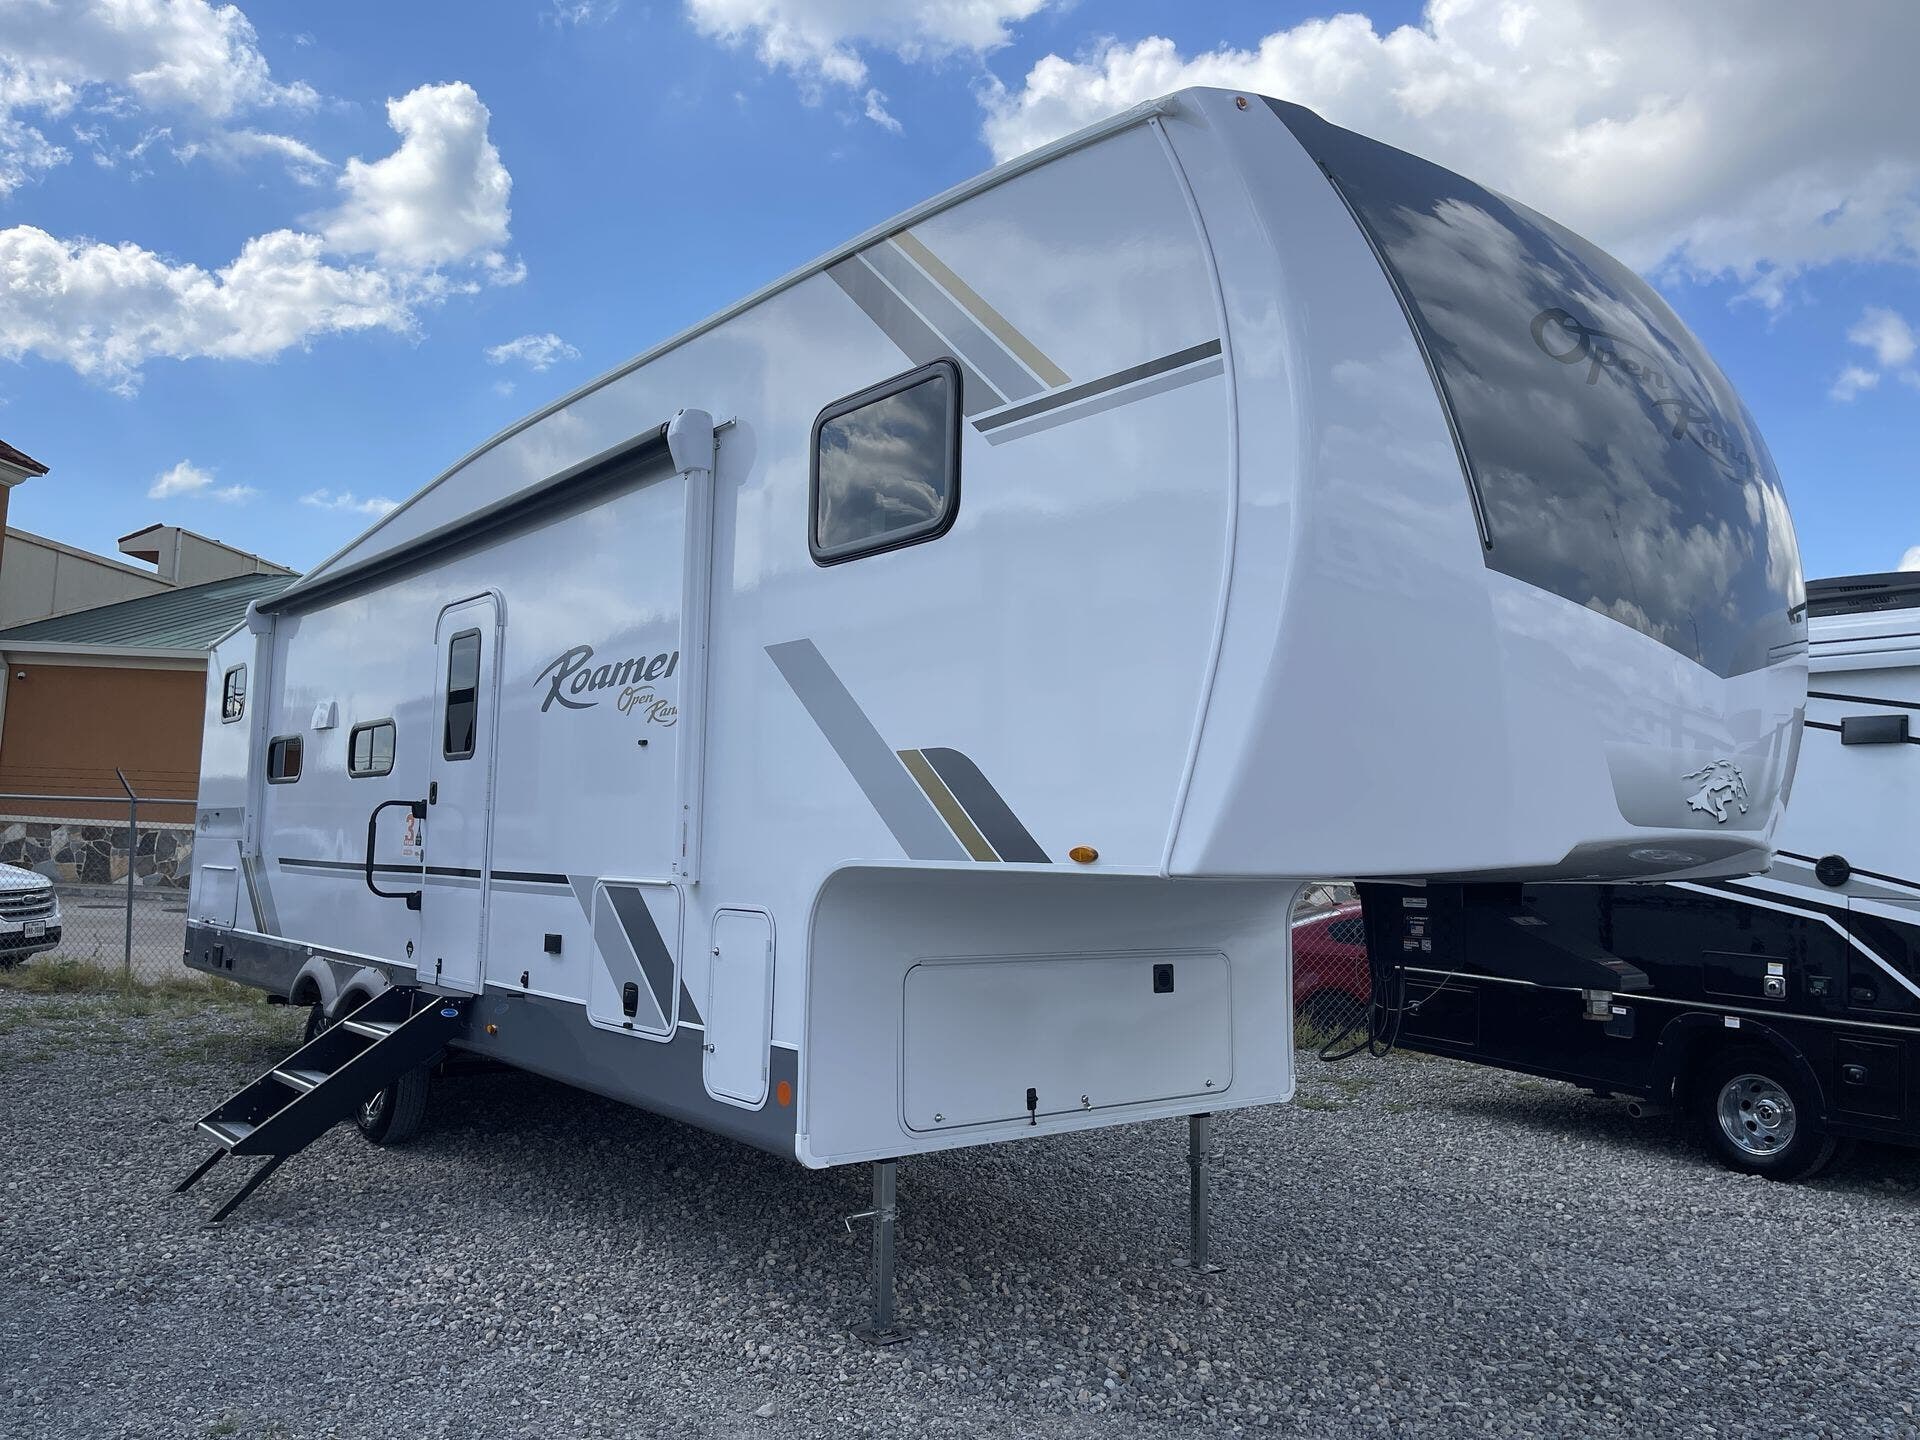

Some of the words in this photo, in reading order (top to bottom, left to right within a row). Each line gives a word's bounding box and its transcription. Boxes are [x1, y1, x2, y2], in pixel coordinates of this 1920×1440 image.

[1530, 308, 1667, 386] Open
[1651, 398, 1756, 486] Rang
[617, 686, 655, 716] Open
[644, 699, 677, 727] Ran
